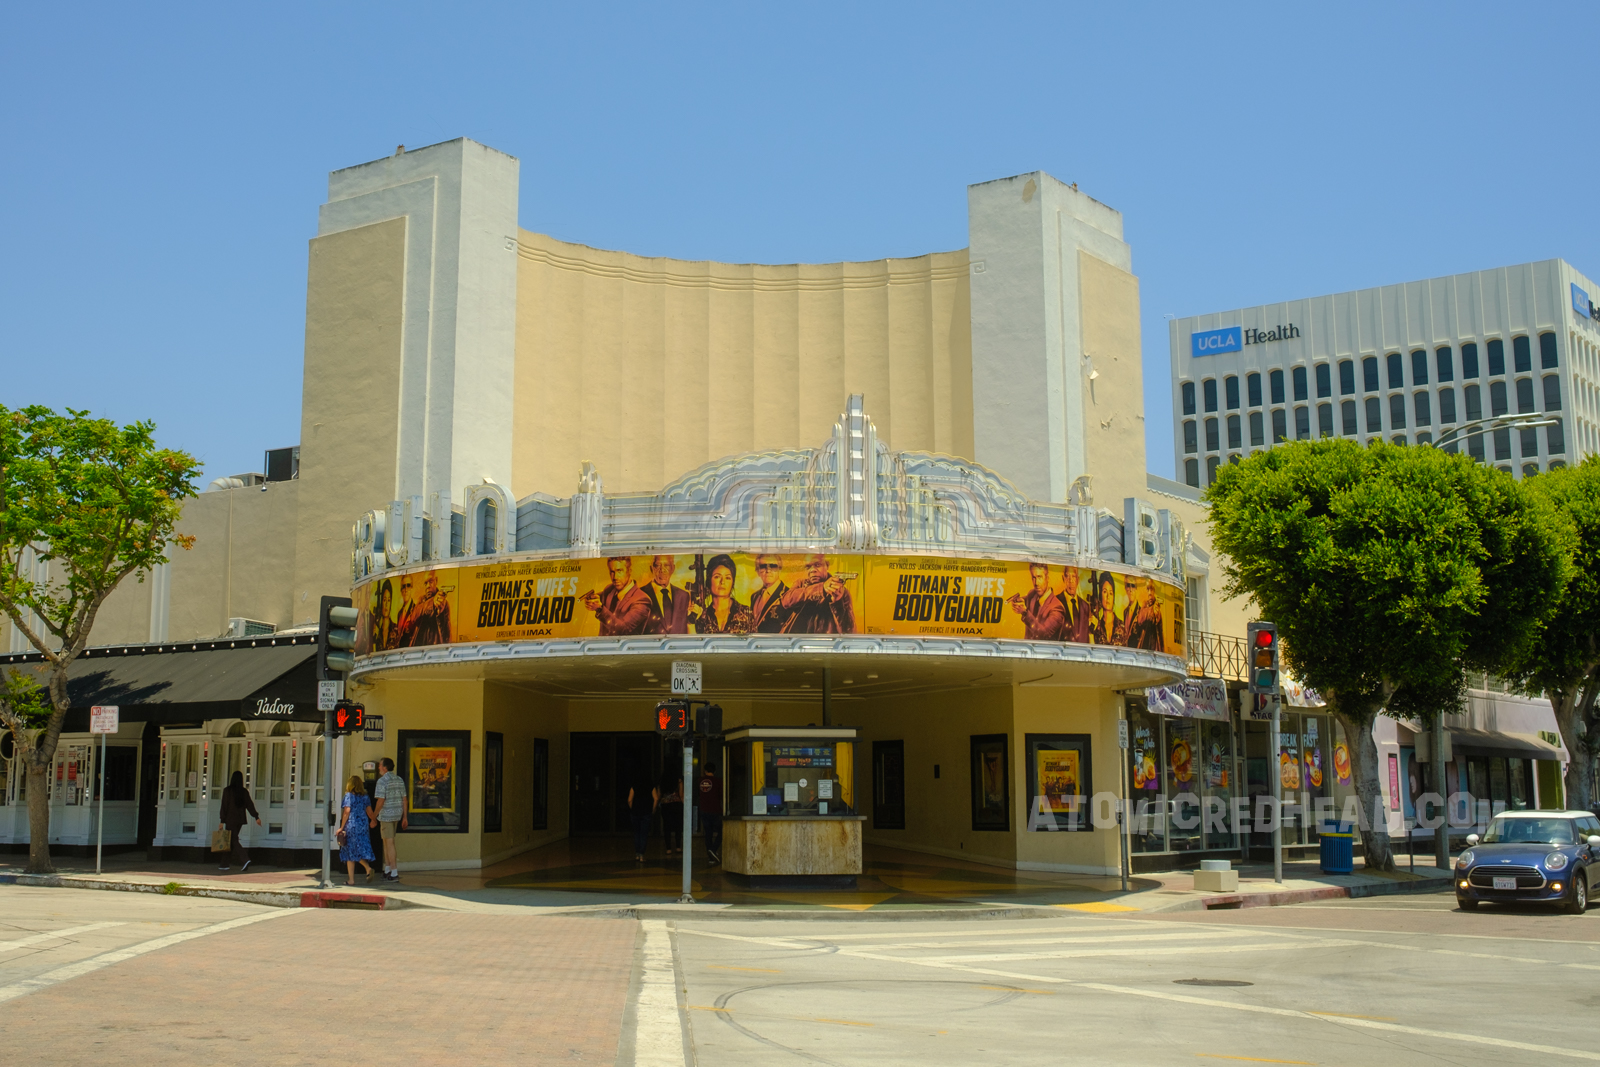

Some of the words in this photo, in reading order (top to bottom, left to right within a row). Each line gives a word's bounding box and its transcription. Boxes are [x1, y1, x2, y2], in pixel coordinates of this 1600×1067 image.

[1198, 333, 1236, 351] UCLA
[1244, 323, 1301, 346] Health
[517, 568, 532, 576] HAYEK
[533, 566, 558, 574] BANDERAS
[559, 565, 582, 573] FREEMAN
[918, 563, 942, 571] JACKSON
[943, 564, 959, 572] HAYEK
[961, 565, 986, 573] BANDERAS
[987, 566, 1008, 574] FREEMAN
[481, 579, 534, 601] HITMAN'S
[536, 577, 579, 597] WIFE'S
[897, 574, 962, 594] HITMAN'S
[965, 576, 1006, 597] WIFE'S
[477, 596, 576, 628] BODYGUARD
[893, 593, 1004, 624] BODYGUARD
[526, 628, 552, 636] IMAX
[919, 626, 945, 634] EXPERIENCE
[956, 627, 984, 635] IMAX
[673, 677, 685, 690] OK
[1205, 685, 1226, 702] OPEN
[92, 707, 101, 715] NO
[254, 697, 295, 717] J'adore
[355, 709, 362, 726] 3
[364, 719, 383, 730] ATM
[678, 709, 686, 728] 3
[1280, 733, 1297, 748] BREAK
[1303, 734, 1316, 748] FAST
